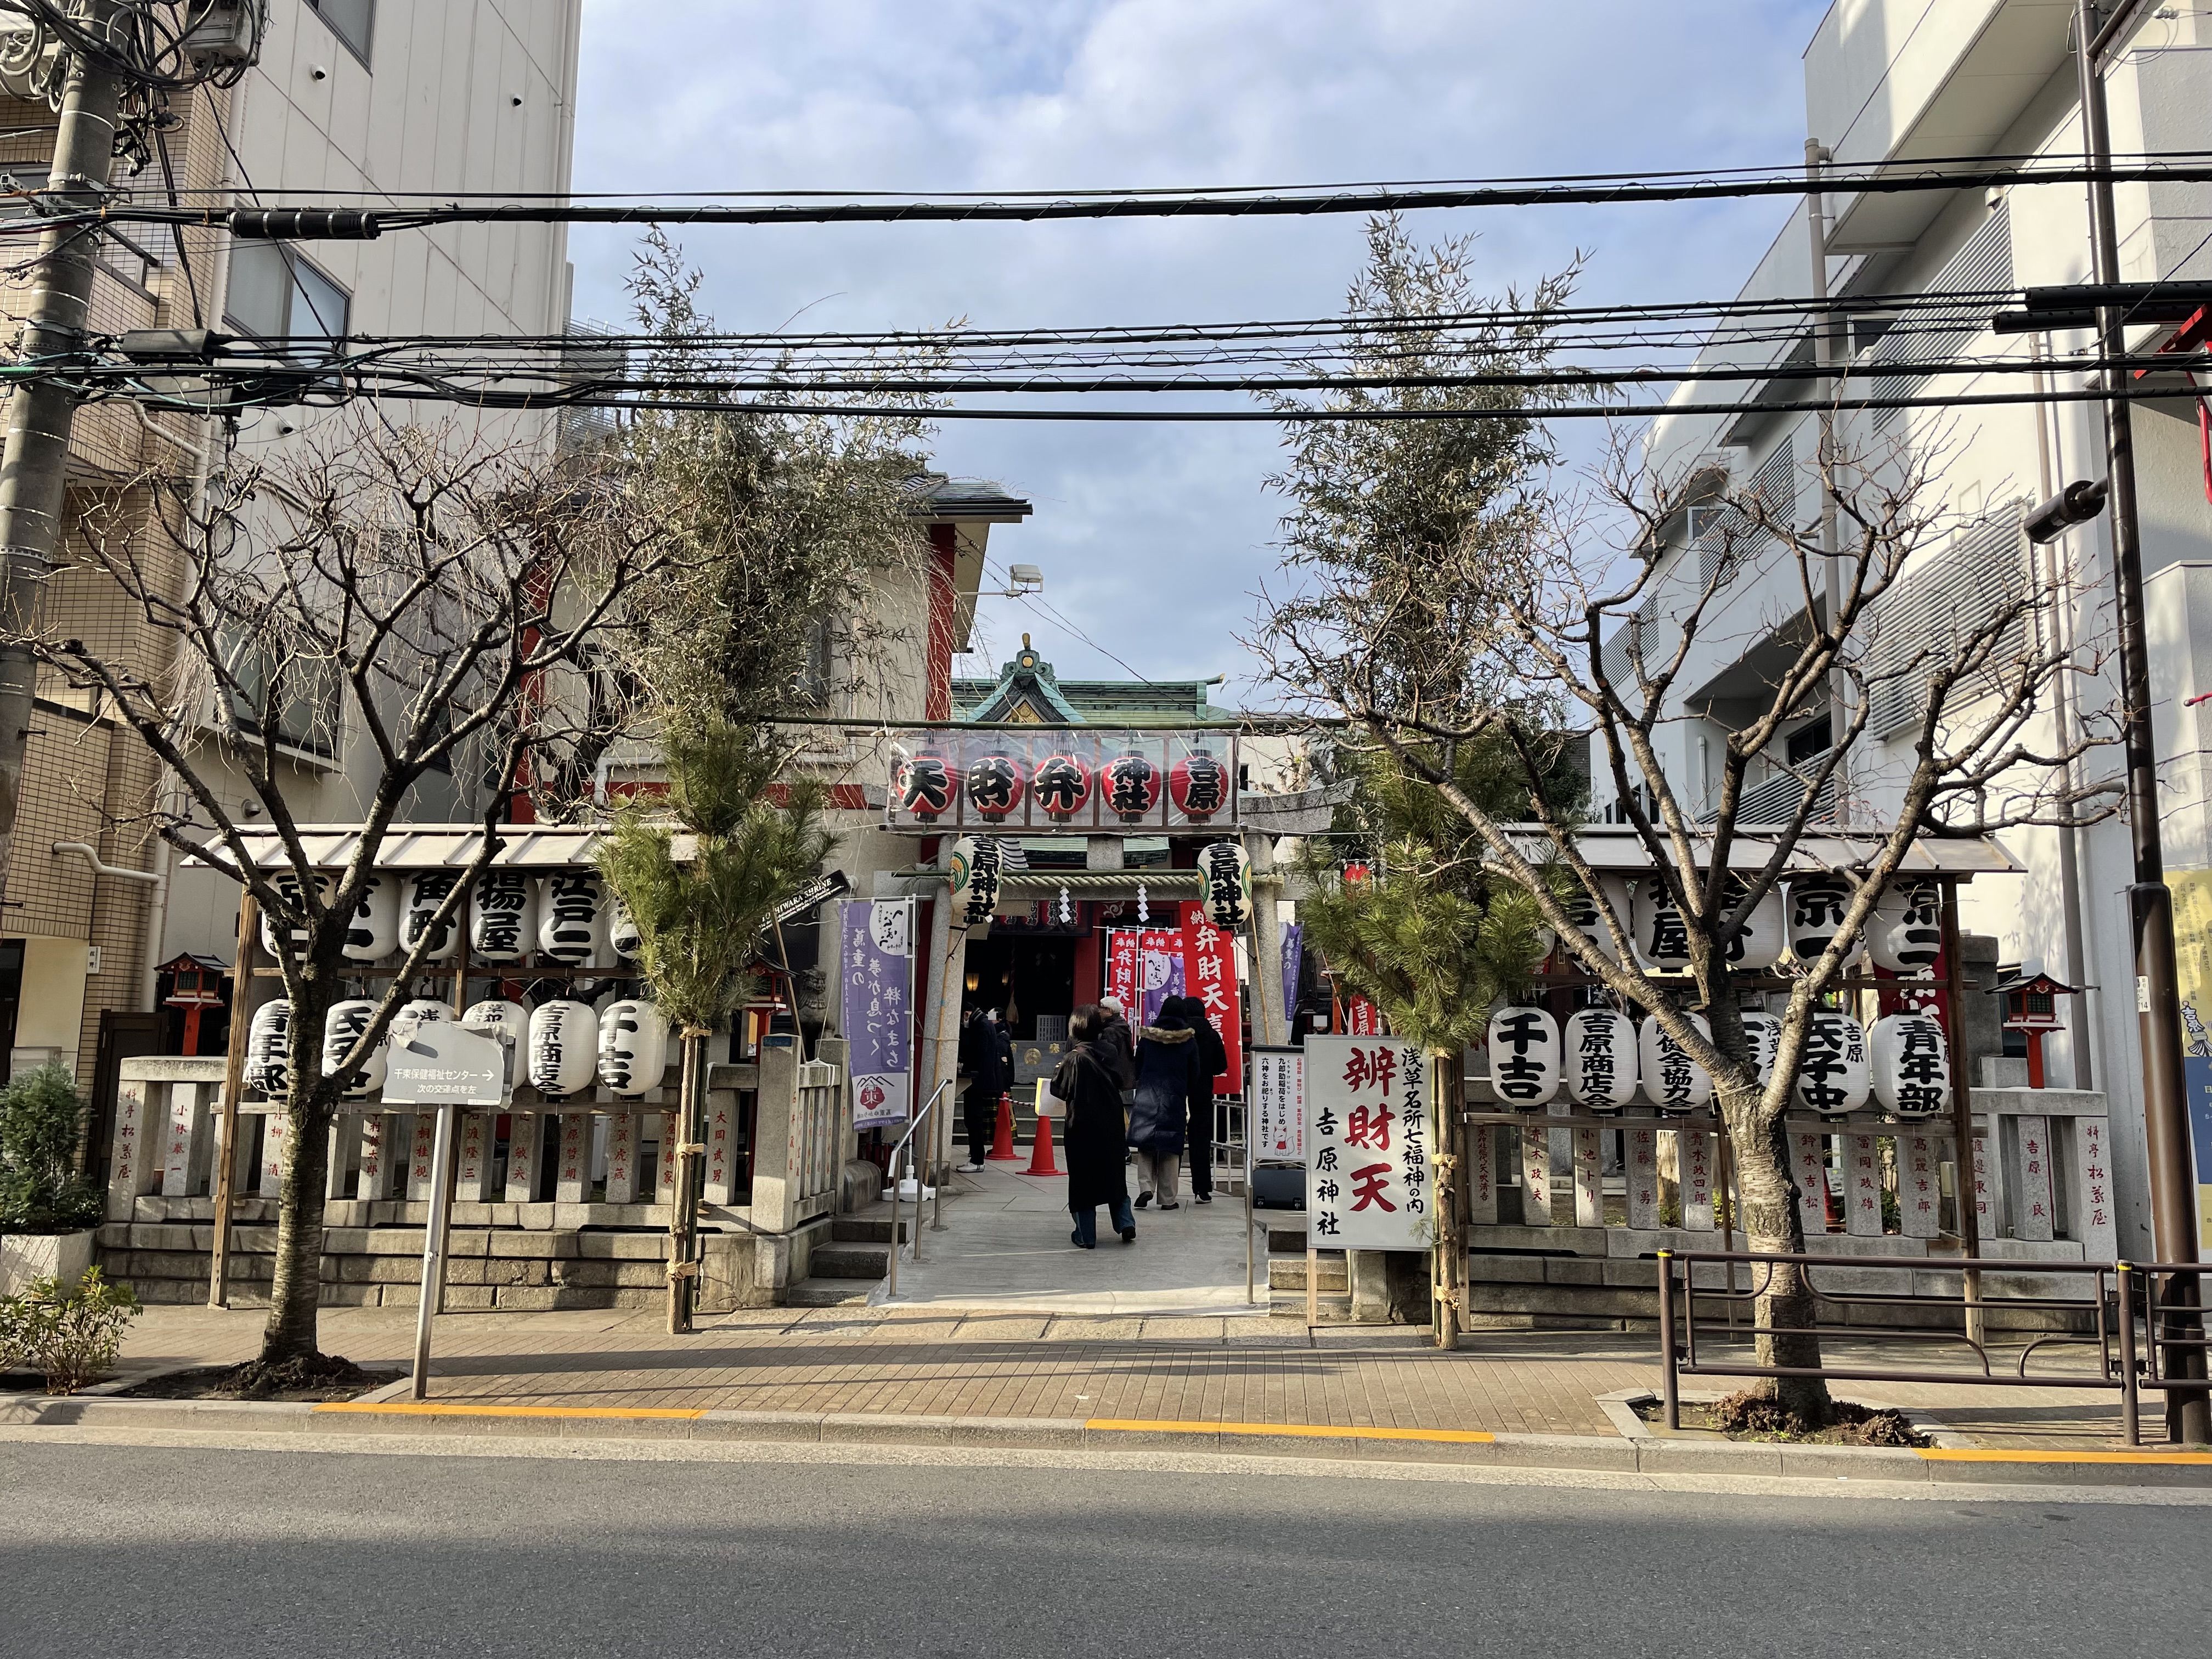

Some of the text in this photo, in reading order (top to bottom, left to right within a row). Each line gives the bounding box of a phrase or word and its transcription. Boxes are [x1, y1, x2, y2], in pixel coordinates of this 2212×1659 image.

[969, 758, 1016, 809] 財
[1034, 758, 1086, 810] 弁
[1110, 758, 1150, 811] 神社
[1187, 757, 1221, 810] 吉原
[476, 872, 527, 953] 揚屋
[549, 870, 598, 957] 江戸二
[763, 894, 804, 922] OHIWARA
[804, 878, 832, 898] SHRINE
[967, 836, 1001, 917] 吉原神社
[1209, 843, 1244, 926] 吉原神社
[1893, 876, 1940, 965] 京二
[1195, 926, 1230, 1011] 弁財天
[394, 1068, 478, 1081] 千束保健福祉センター
[532, 1005, 571, 1092] 吉原商店会
[1497, 1012, 1548, 1099] 千吉
[1578, 1013, 1618, 1107] 吉原商店会
[1801, 1019, 1849, 1110] 氏子中
[1843, 1023, 1864, 1063] 吉原
[1897, 1020, 1945, 1113] 青年部
[712, 1110, 727, 1182] 大岡武男
[1401, 1047, 1425, 1214] 浅草名所七福神の内
[1530, 1127, 1543, 1201] 青木政夫
[1582, 1129, 1596, 1203] 小池トリ
[1636, 1131, 1651, 1205] 佐藤勇
[1691, 1132, 1707, 1205] 青木政四郎
[1315, 1107, 1341, 1236] 吉原神社
